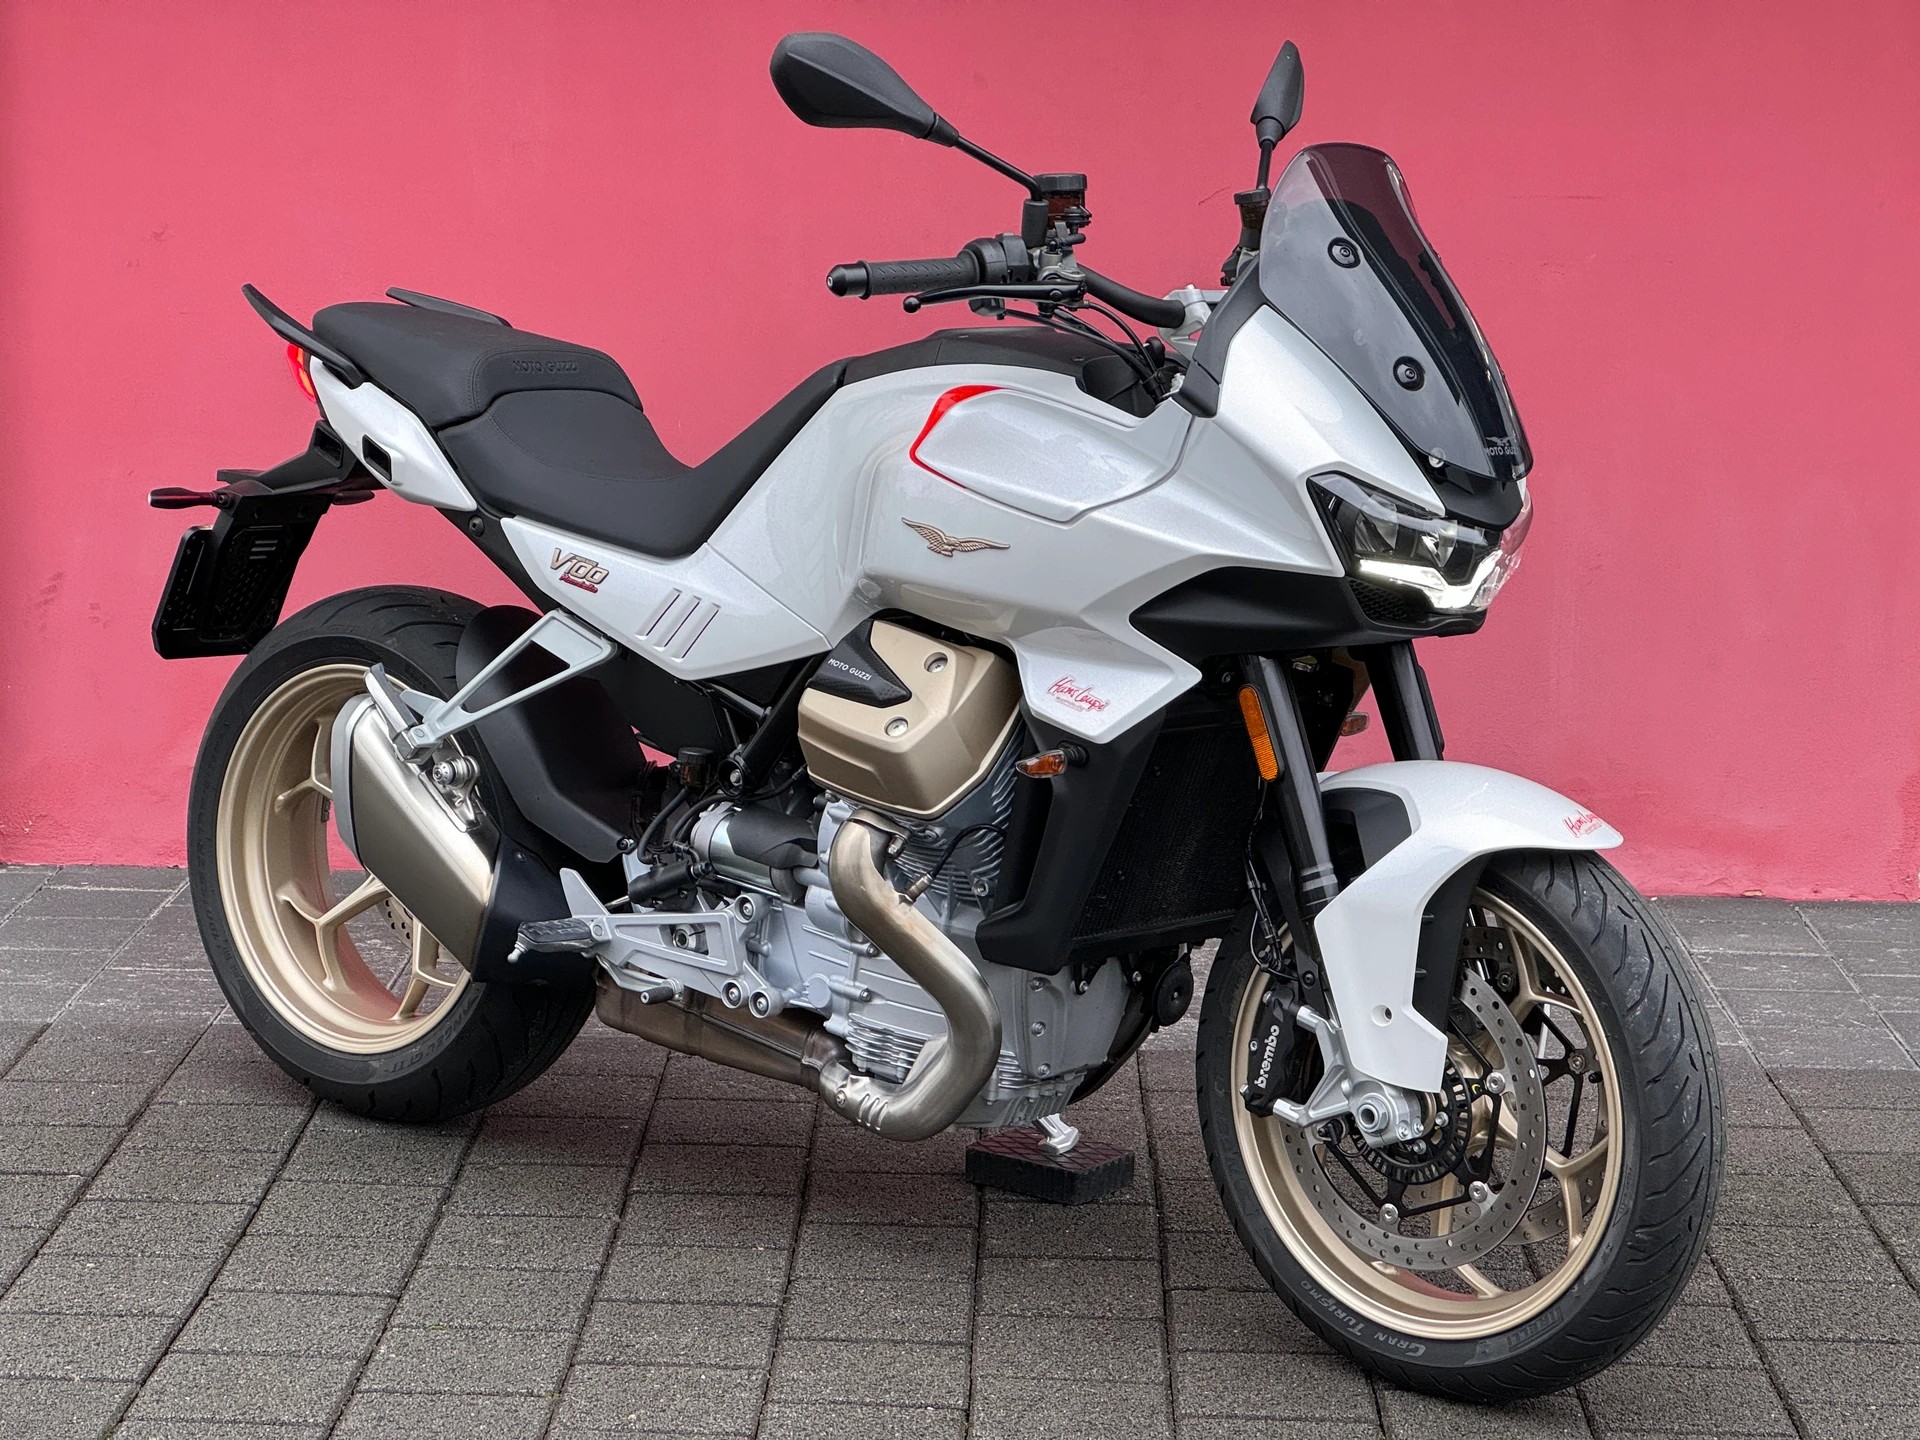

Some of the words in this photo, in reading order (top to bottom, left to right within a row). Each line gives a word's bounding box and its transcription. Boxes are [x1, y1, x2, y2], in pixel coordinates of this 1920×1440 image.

[512, 360, 543, 373] MOTO
[1484, 446, 1504, 456] MOTO
[550, 547, 609, 585] V100
[827, 658, 849, 671] MOTO
[849, 667, 872, 681] GUZZI
[1254, 1024, 1280, 1089] brembo
[1300, 1279, 1366, 1336] TURISMO
[1373, 1331, 1427, 1357] GRAN
